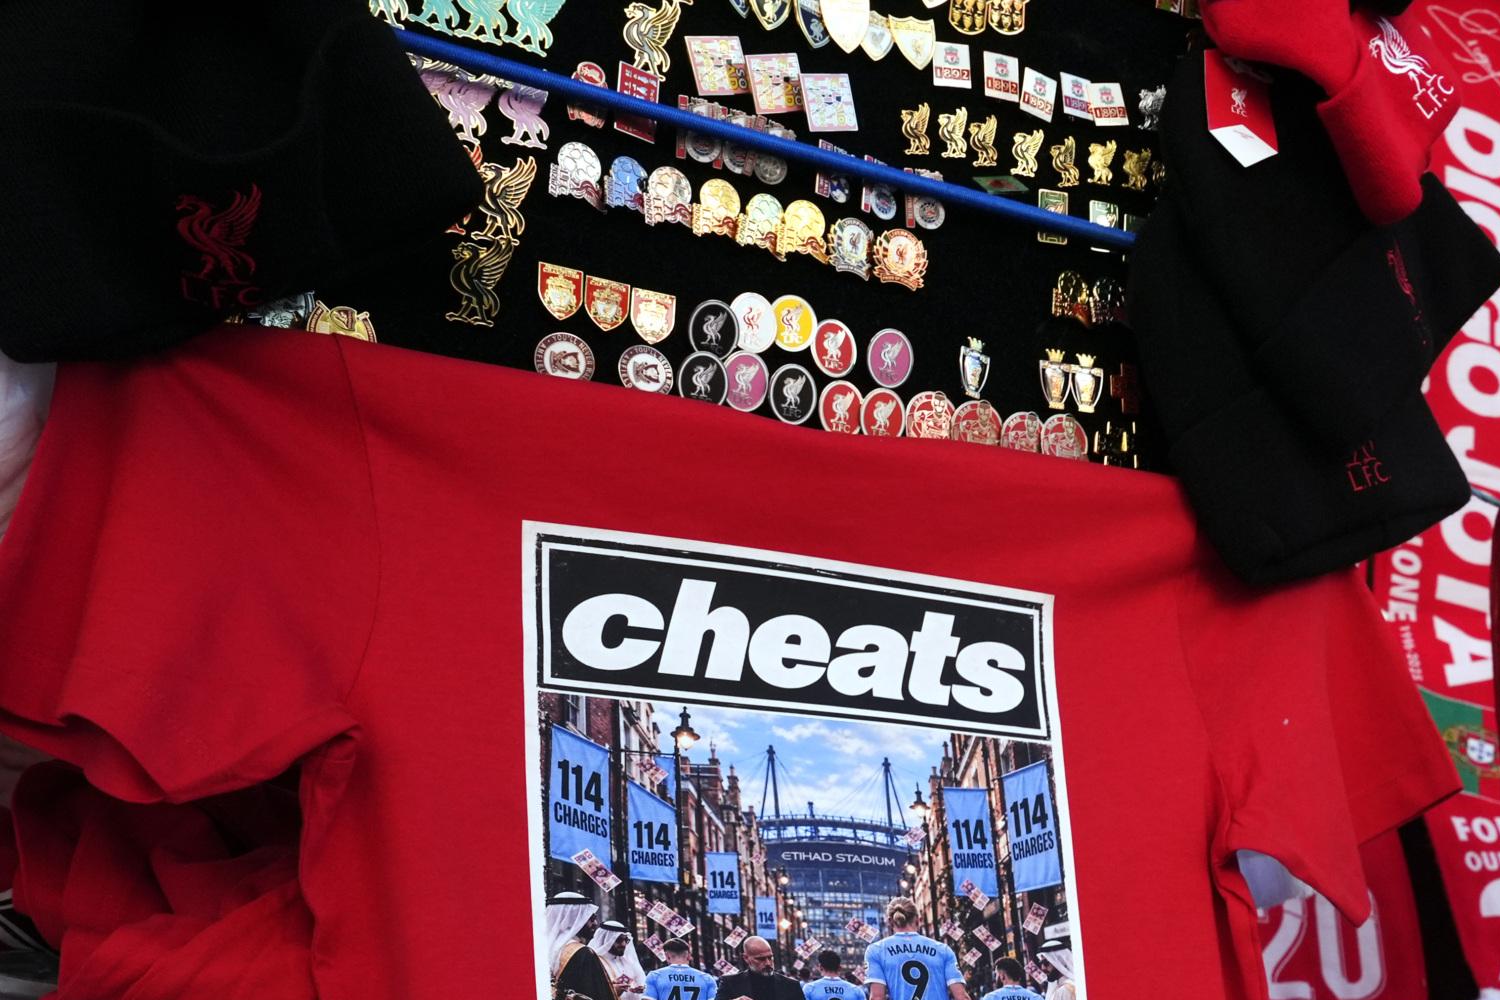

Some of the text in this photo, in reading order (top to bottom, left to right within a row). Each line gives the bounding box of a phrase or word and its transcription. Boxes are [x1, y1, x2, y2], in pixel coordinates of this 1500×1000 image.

[935, 67, 970, 80] 1892
[987, 77, 1018, 95] 1892
[1095, 107, 1126, 118] 1892
[562, 578, 1027, 713] cheats
[557, 759, 605, 813] 114
[554, 801, 608, 838] CHARGES
[1009, 792, 1050, 838] 114
[633, 820, 672, 851] 114
[952, 818, 989, 851] 114
[1012, 830, 1055, 861] CHARGES
[631, 850, 675, 868] CHARGES
[781, 851, 896, 868] ETIHAD STADIUM
[954, 852, 994, 871] CHARGES
[710, 870, 736, 889] 114
[709, 889, 738, 900] CHARGES
[758, 911, 775, 923] 114
[887, 944, 937, 957] HAALAND
[668, 974, 695, 983] FODEN
[824, 986, 845, 995] ENZO
